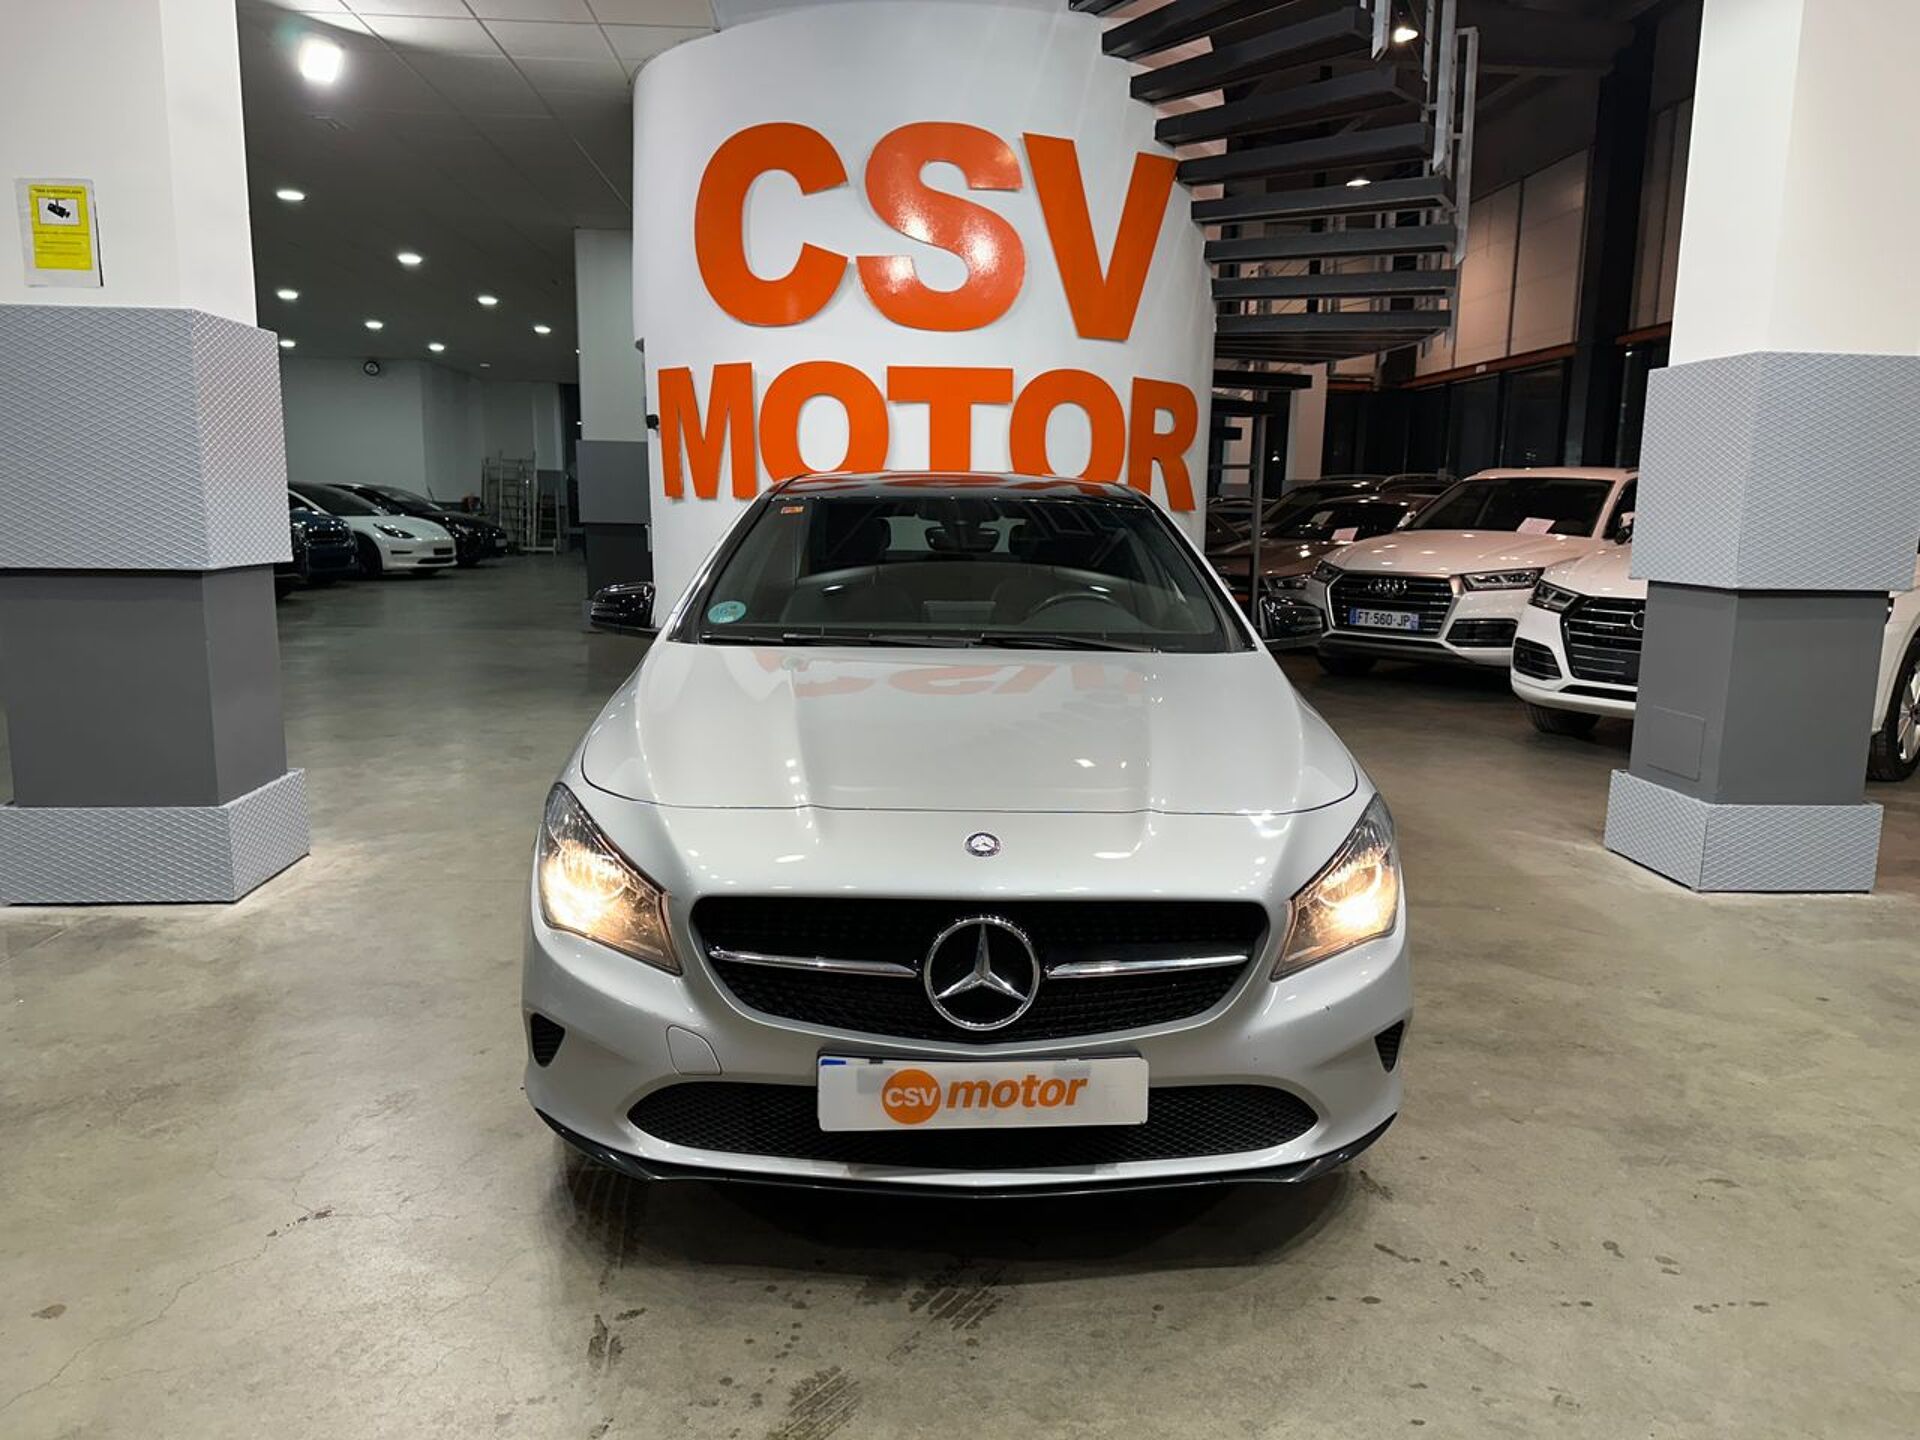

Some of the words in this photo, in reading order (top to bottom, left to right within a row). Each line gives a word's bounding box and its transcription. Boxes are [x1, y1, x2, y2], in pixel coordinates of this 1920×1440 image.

[694, 121, 1180, 341] CSV
[658, 361, 1198, 511] MOTOR
[946, 1074, 1089, 1109] motor
